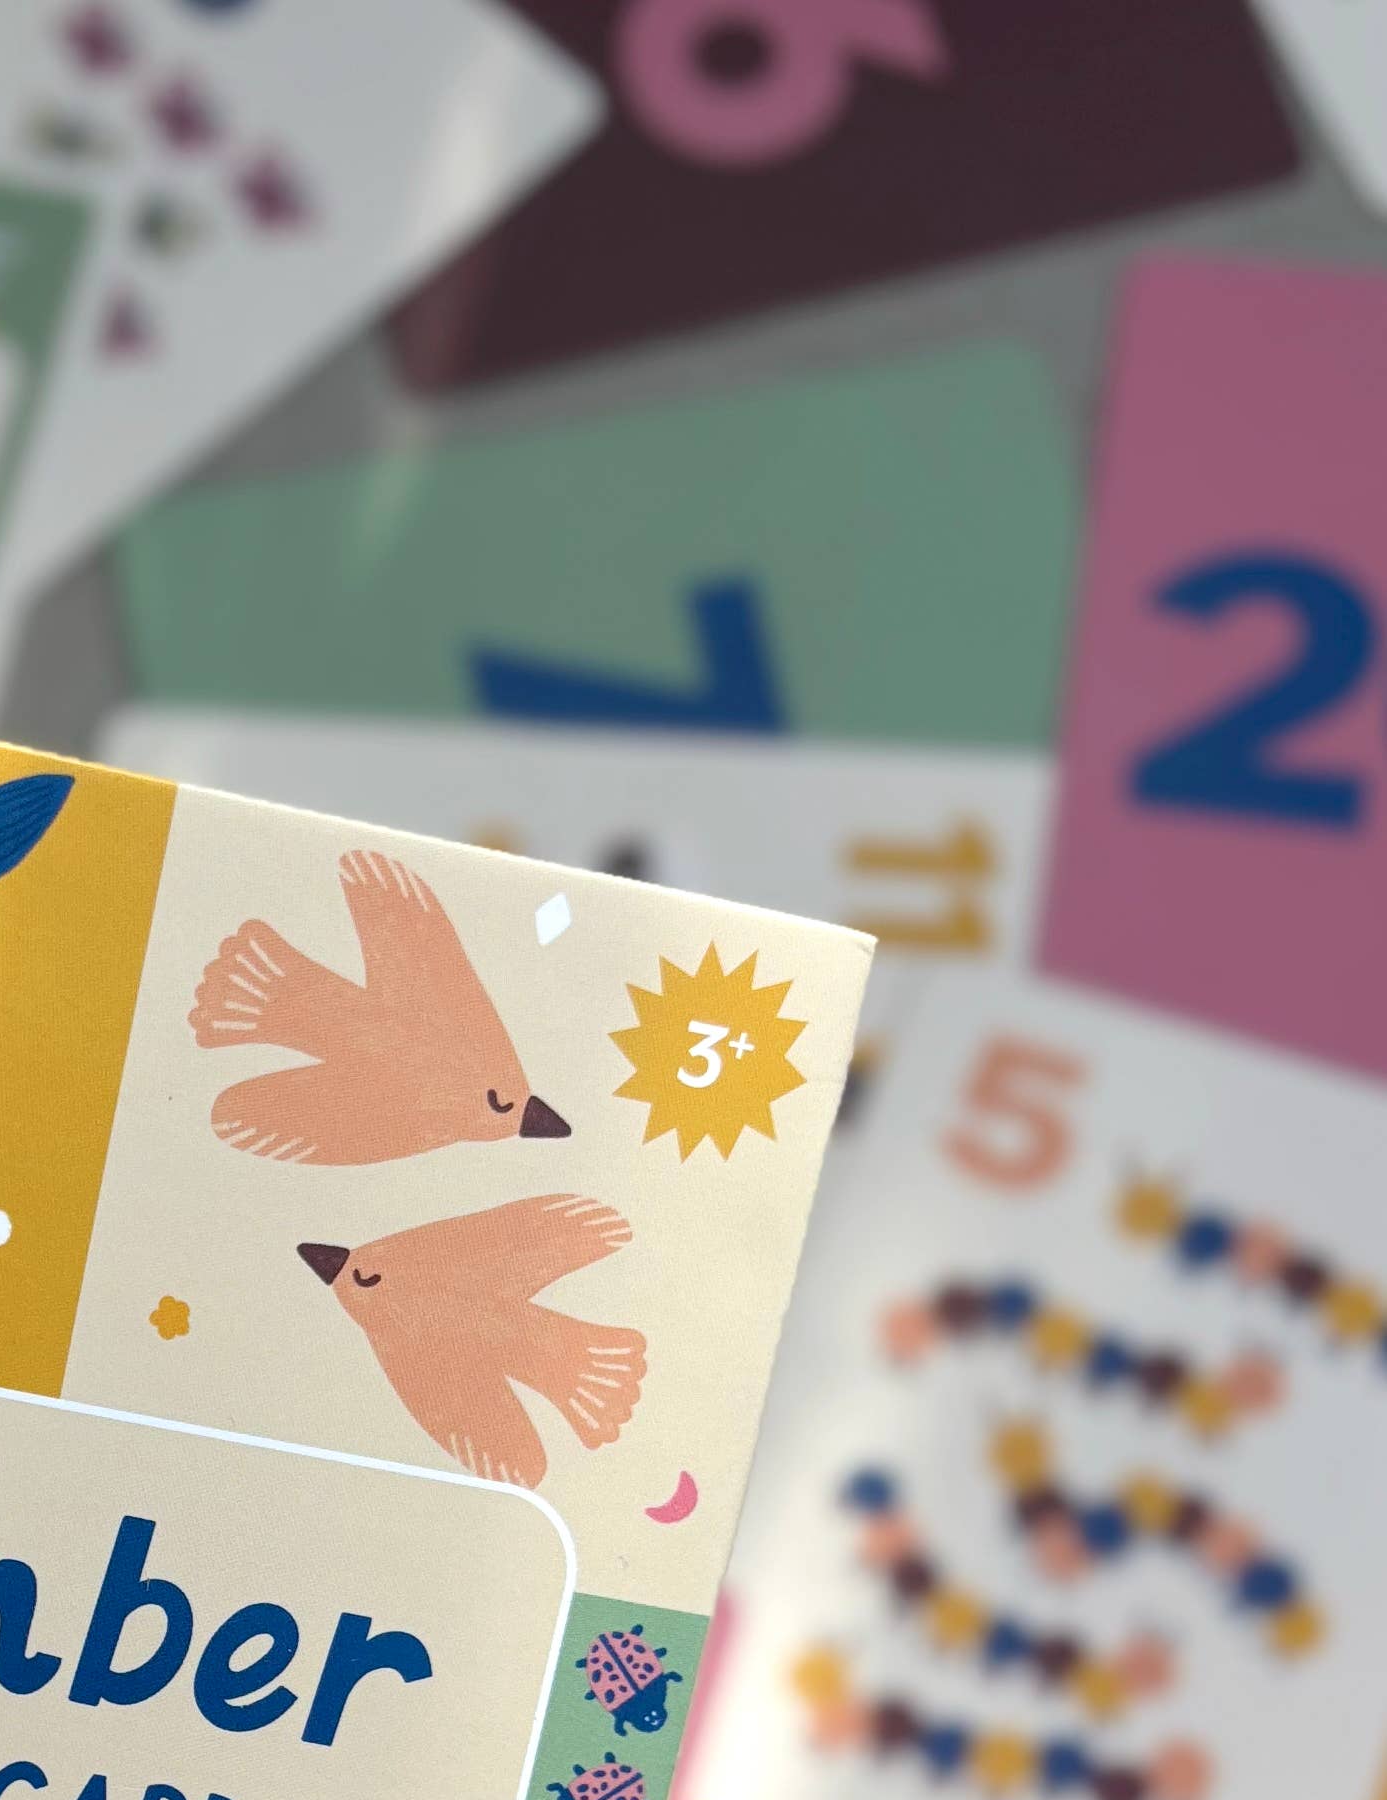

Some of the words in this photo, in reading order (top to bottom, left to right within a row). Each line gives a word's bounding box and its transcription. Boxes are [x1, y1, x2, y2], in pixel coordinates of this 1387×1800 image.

[1130, 553, 1387, 831] 2
[675, 1018, 756, 1090] 3+
[937, 1032, 1092, 1194] 5
